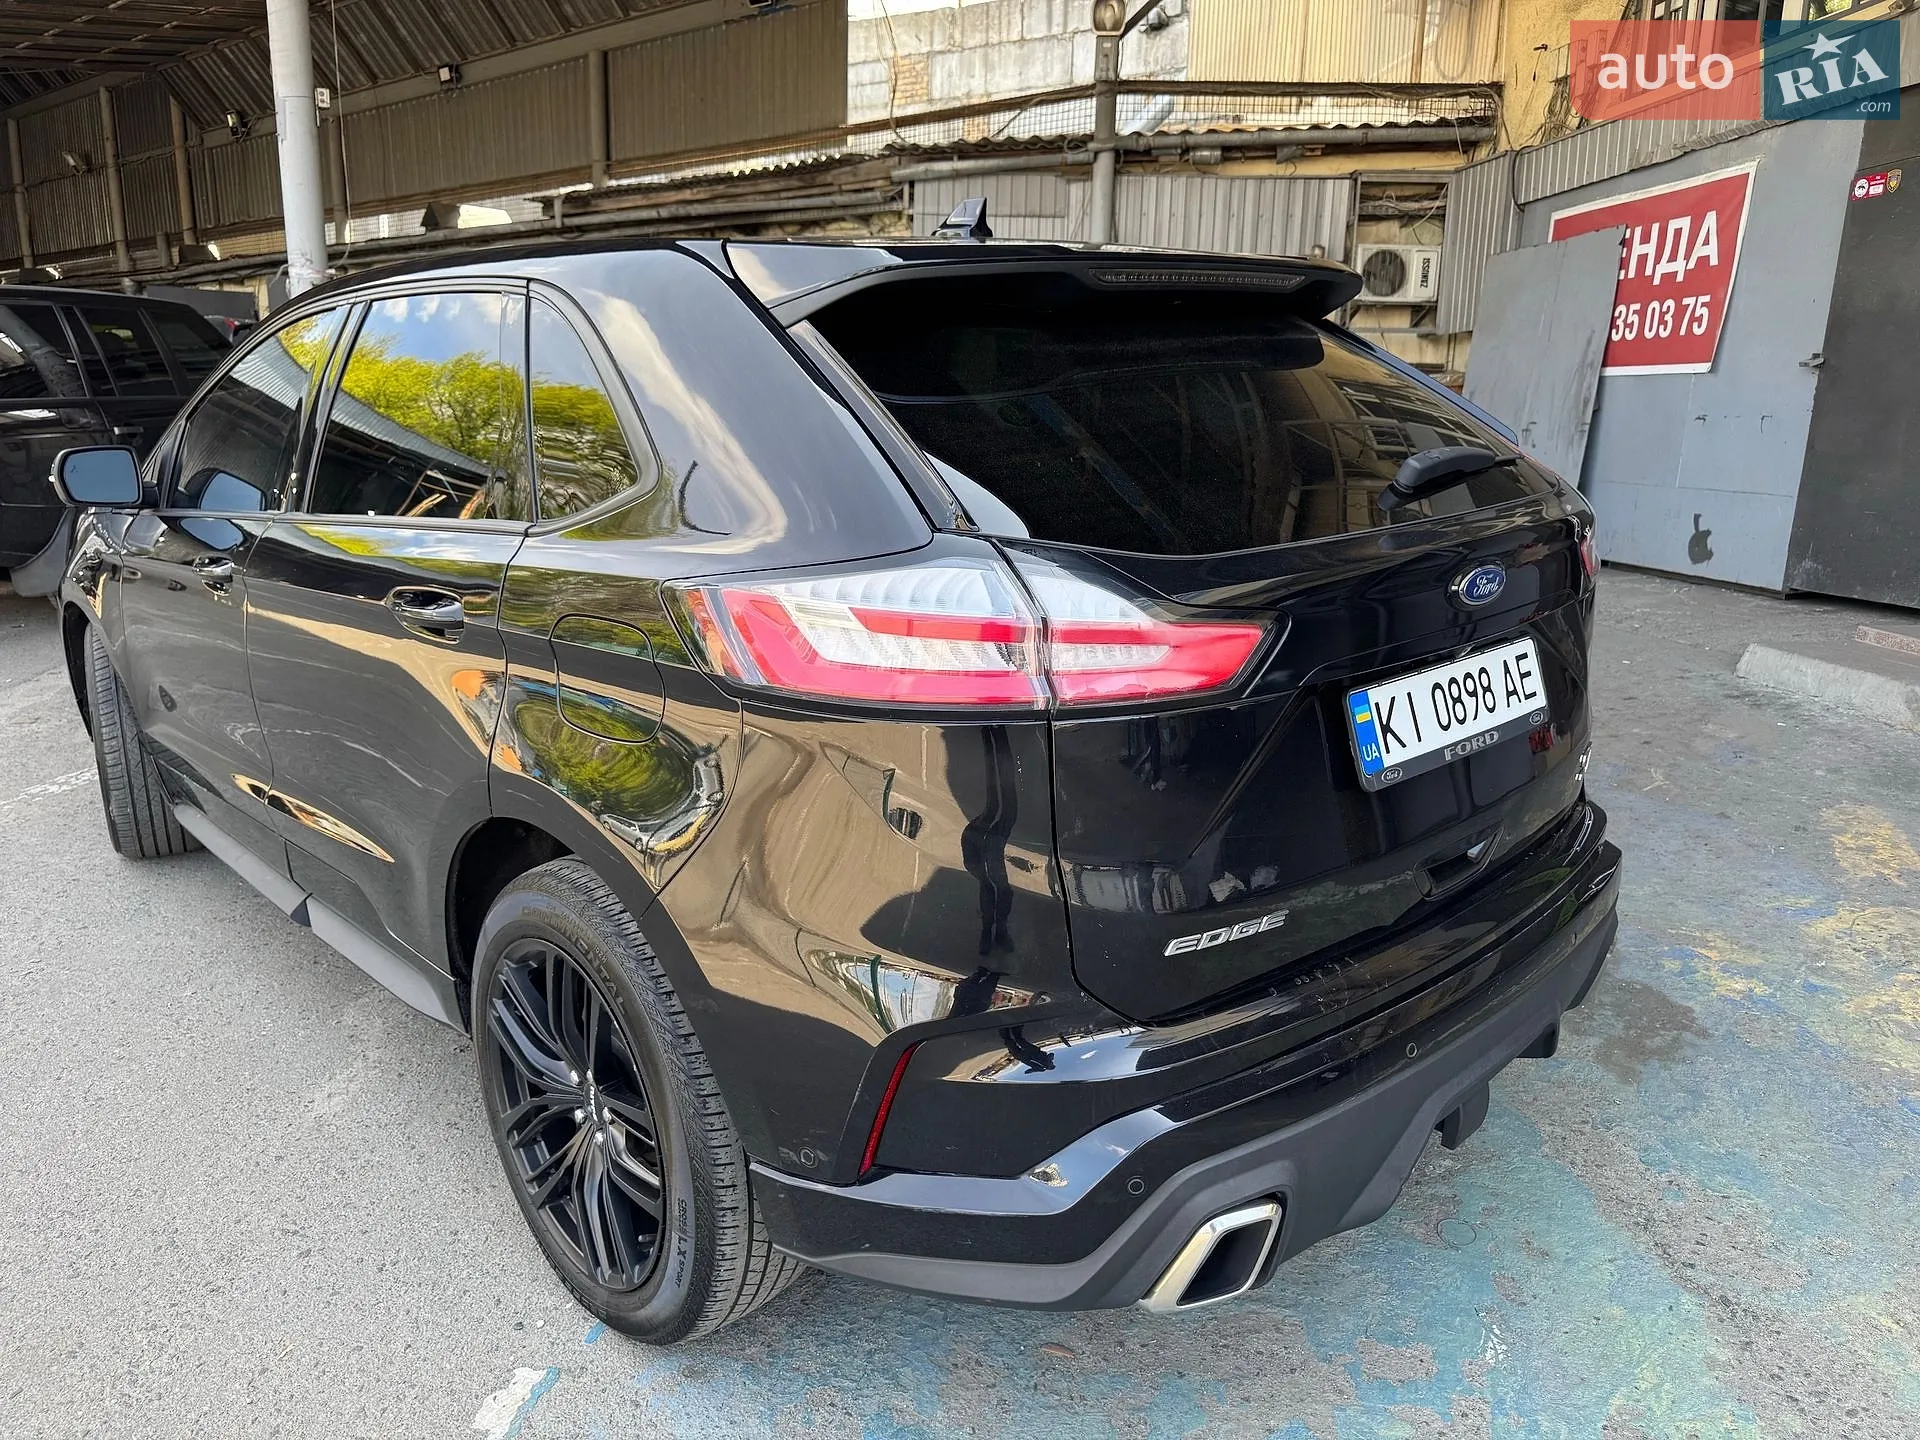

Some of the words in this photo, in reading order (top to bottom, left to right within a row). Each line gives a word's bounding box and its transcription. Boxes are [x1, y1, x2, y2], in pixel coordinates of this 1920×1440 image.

[1611, 303, 1641, 341] 35
[1644, 299, 1675, 338] 03
[1680, 295, 1711, 336] 75
[1473, 574, 1500, 597] Ford
[1374, 692, 1422, 754] KI
[1431, 667, 1496, 732] 0898
[1502, 652, 1537, 708] AE
[1363, 744, 1380, 761] UA
[1444, 730, 1499, 761] FORD
[1163, 910, 1290, 957] EDGE
[676, 1234, 688, 1261] LX
